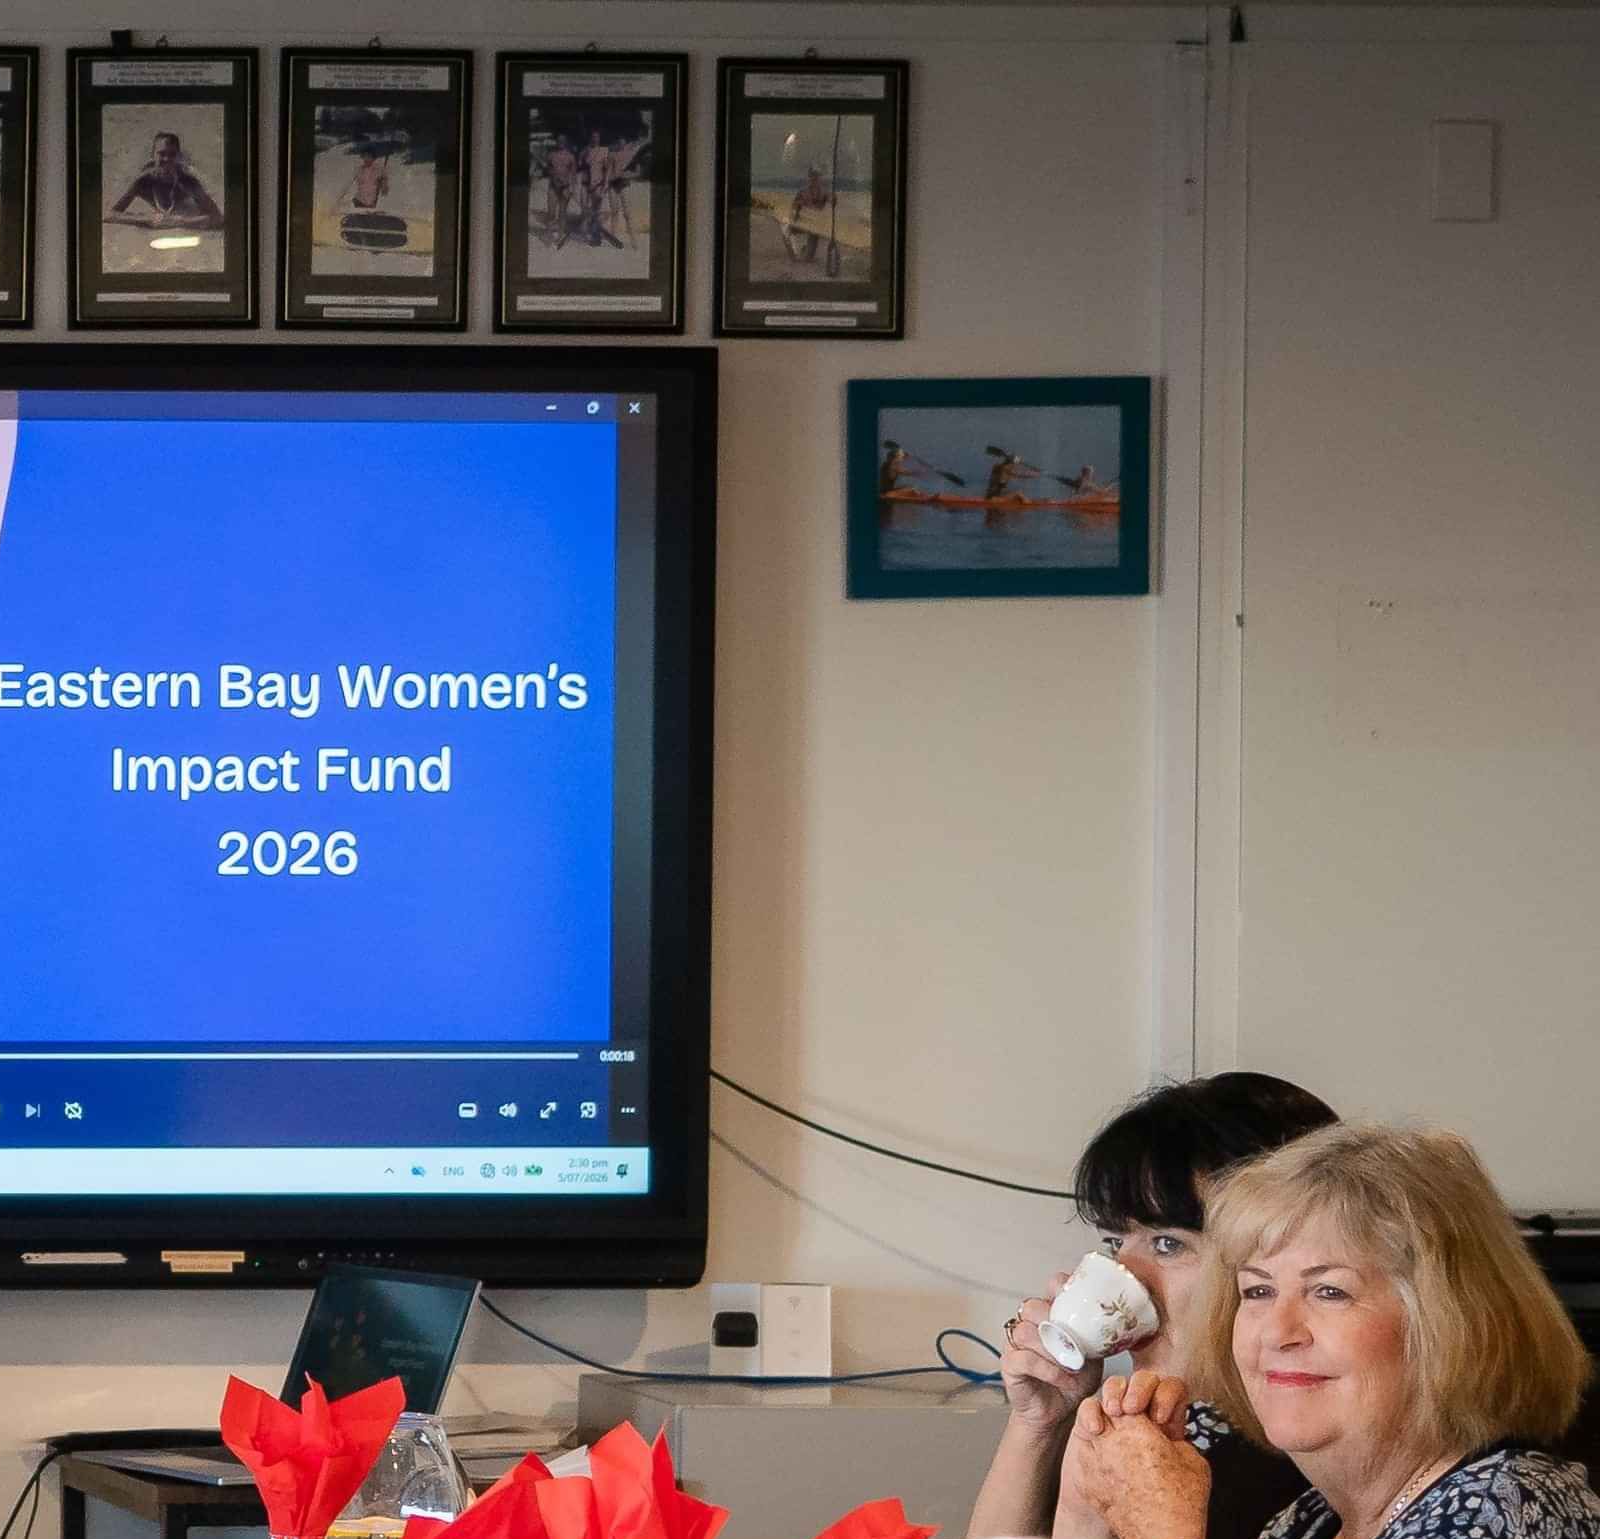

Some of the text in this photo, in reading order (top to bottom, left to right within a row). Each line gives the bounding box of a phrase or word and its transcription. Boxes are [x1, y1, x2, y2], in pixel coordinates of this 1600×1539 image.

[219, 664, 321, 718] Bay
[337, 663, 588, 710] Women's
[112, 746, 452, 801] Impact Fund
[217, 830, 359, 876] 2026
[442, 1166, 465, 1176] ENG
[591, 1159, 608, 1169] pm
